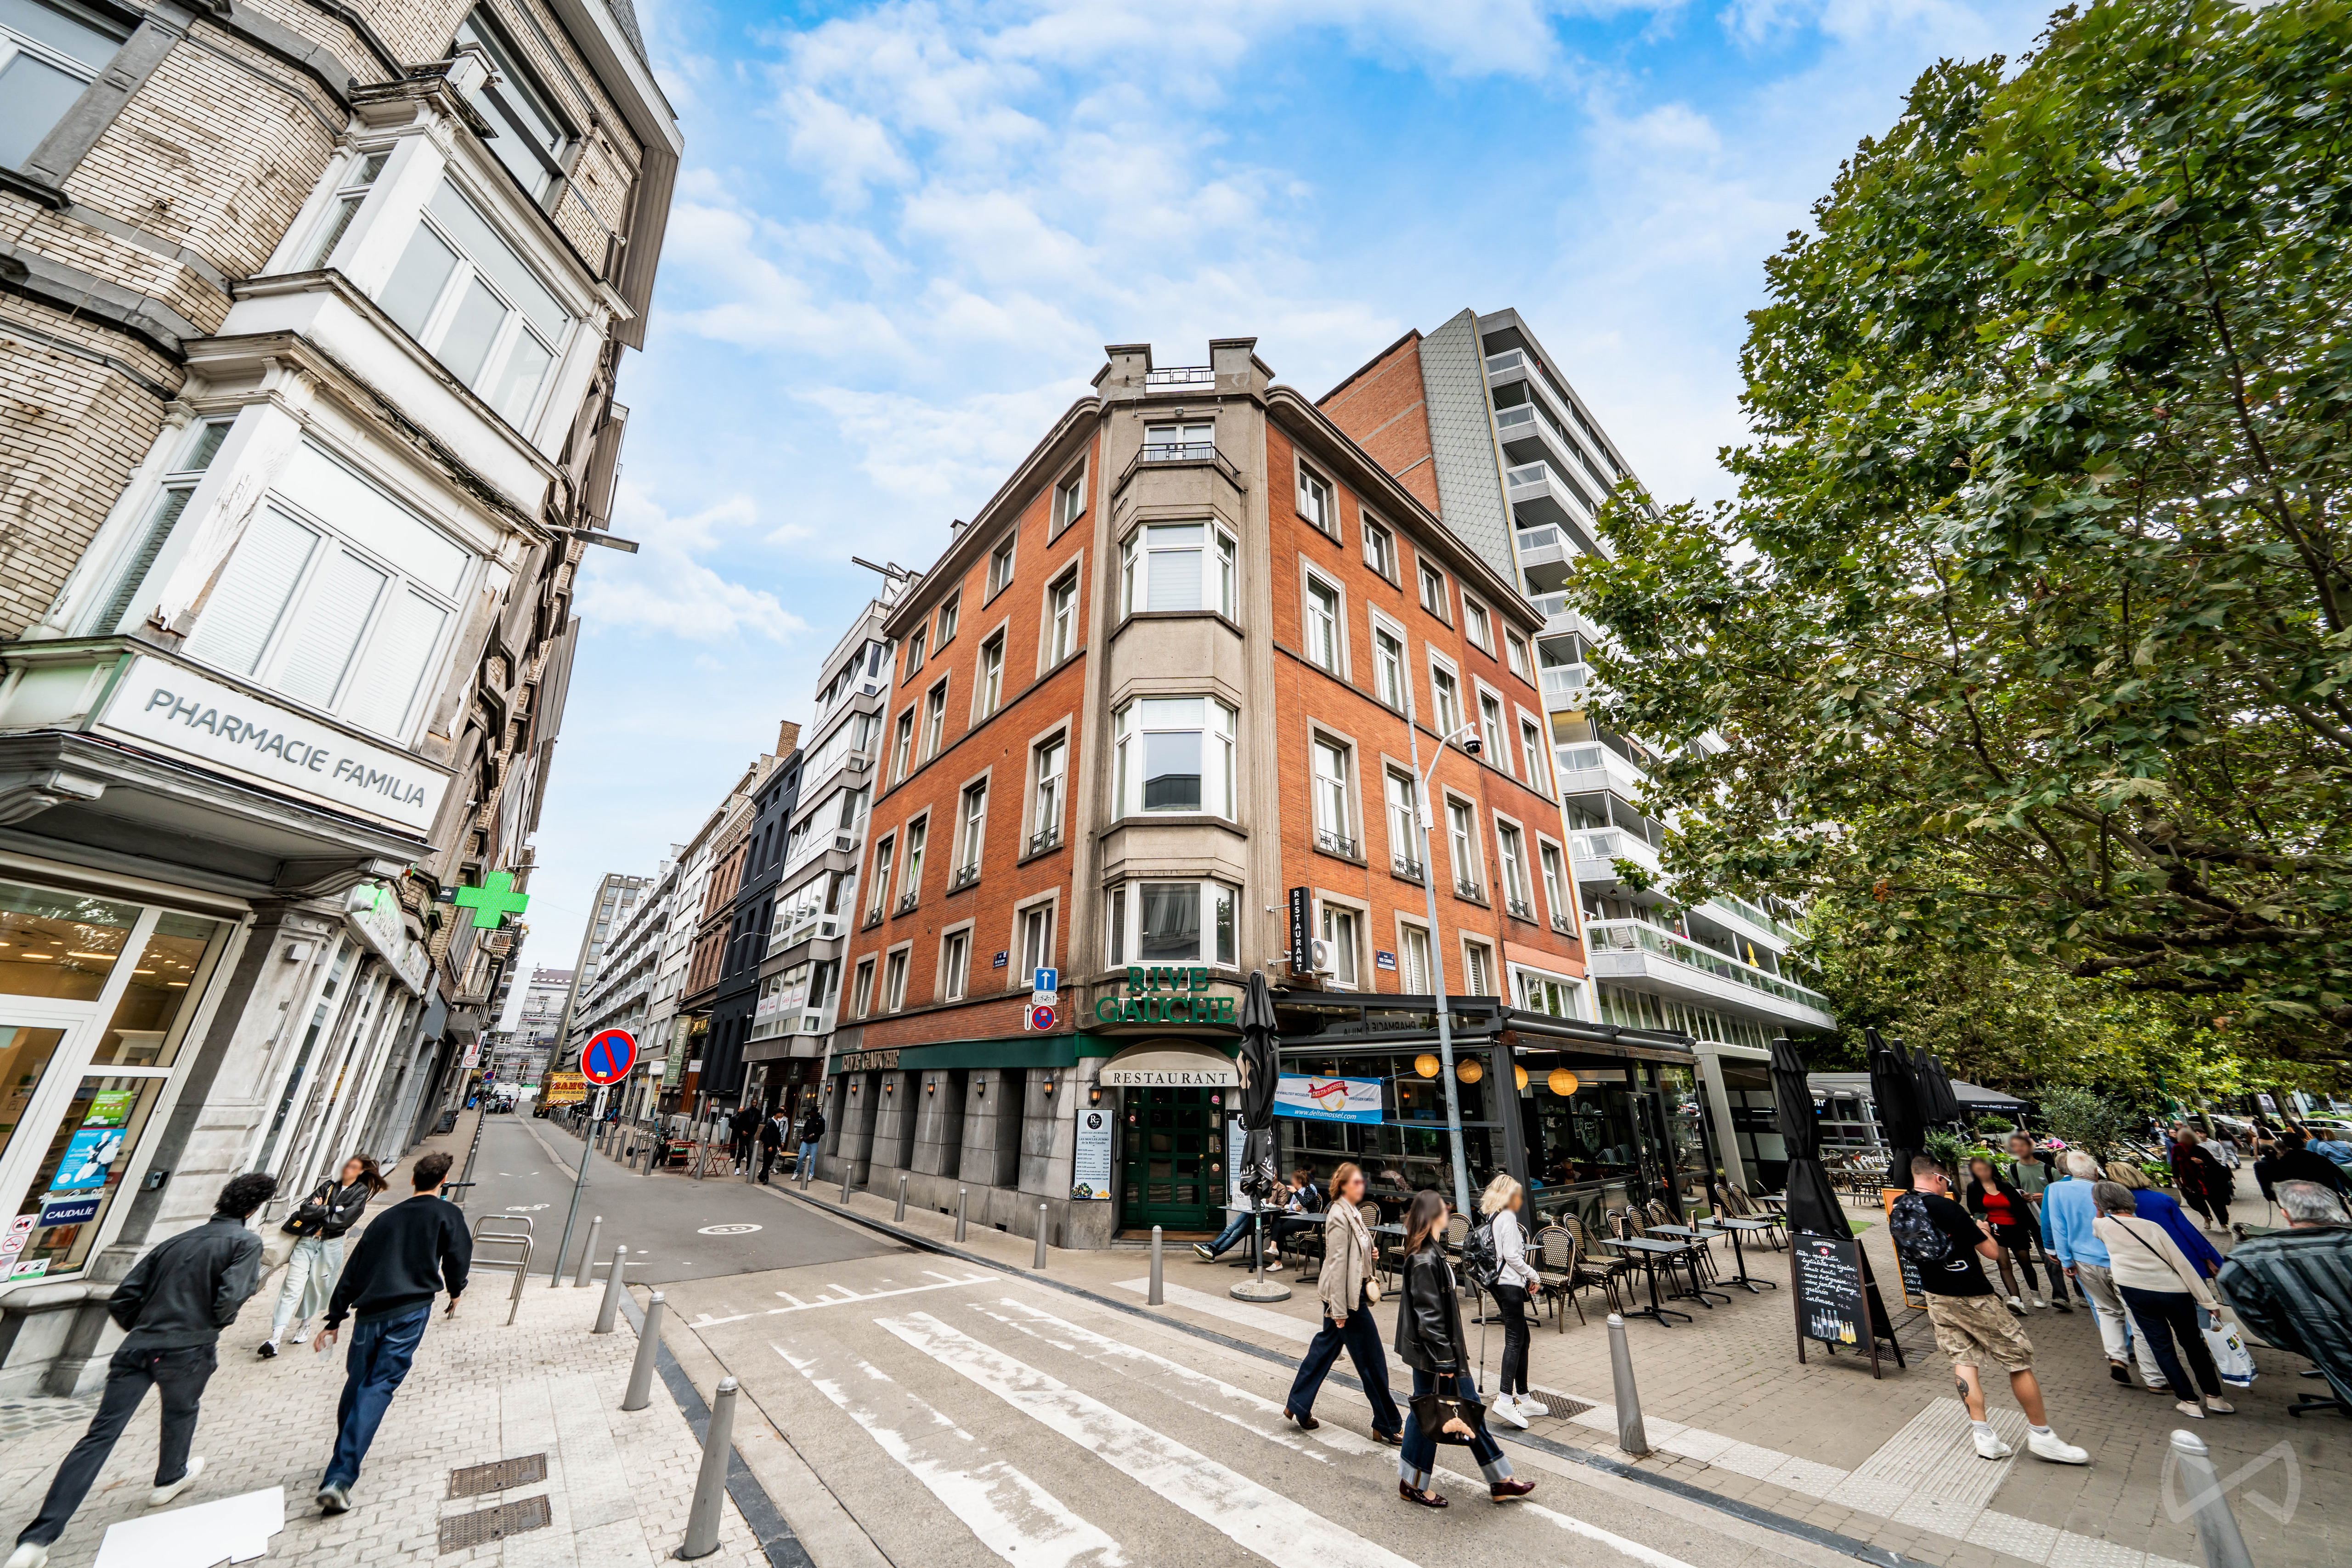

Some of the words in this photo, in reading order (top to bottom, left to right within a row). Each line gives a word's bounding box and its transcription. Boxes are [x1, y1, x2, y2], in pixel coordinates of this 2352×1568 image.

[145, 688, 329, 772] PHARMACIE
[333, 759, 424, 808] FAMILIA
[1126, 967, 1209, 992] RIVE
[1096, 996, 1236, 1023] GAUCHE
[841, 1053, 861, 1072] RIVE
[862, 1050, 899, 1070] GAUCHE
[1113, 1072, 1227, 1084] RESTAURANT
[1327, 1082, 1344, 1093] MOSSEL
[1295, 1109, 1357, 1120] www.deltamossel.com
[1812, 1241, 1837, 1250] GEROLSTEINER
[1819, 1274, 1847, 1285] bolognaise
[1836, 1284, 1857, 1296] fromage
[1805, 1296, 1836, 1306] carbonara
